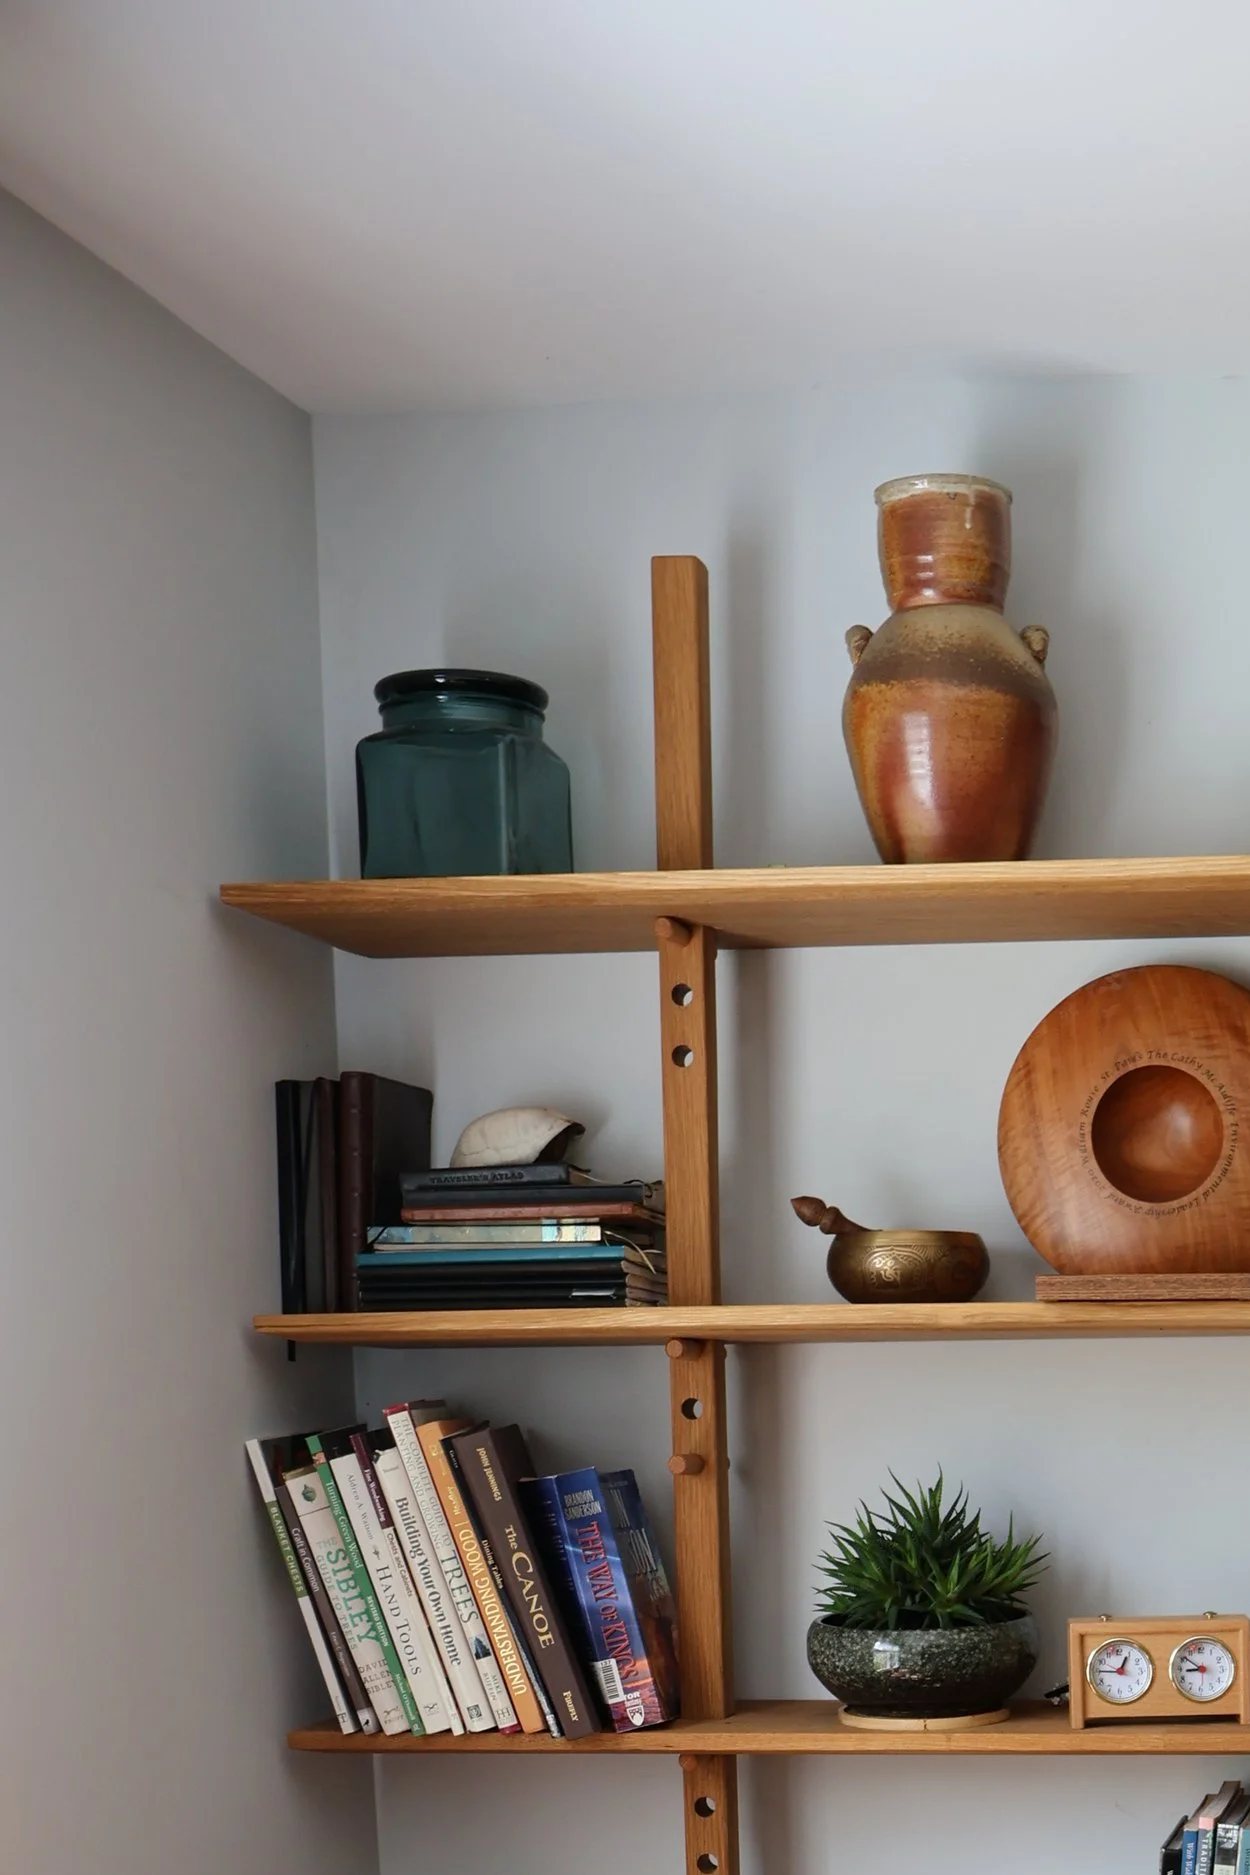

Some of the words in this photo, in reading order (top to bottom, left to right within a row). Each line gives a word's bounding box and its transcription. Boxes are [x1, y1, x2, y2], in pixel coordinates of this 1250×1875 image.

[491, 1171, 525, 1181] ATLAS
[391, 1420, 417, 1474] PLANTING
[410, 1475, 425, 1498] AND
[420, 1500, 445, 1550] GROWING
[476, 1447, 491, 1469] JOHN
[484, 1466, 502, 1502] JENNINGS
[563, 1489, 595, 1508] BRANDON
[563, 1500, 603, 1522] SANDERSON
[270, 1507, 290, 1552] BLANKET
[286, 1554, 304, 1592] CHESTS
[291, 1527, 304, 1547] Craft
[302, 1556, 320, 1593] Common
[459, 1529, 485, 1577] WOOD
[505, 1524, 518, 1550] The
[575, 1520, 605, 1564] THE
[326, 1548, 380, 1643] SIBLEY
[395, 1497, 425, 1559] Building
[417, 1558, 437, 1590] Your
[427, 1590, 448, 1622] Own
[439, 1623, 462, 1666] Home
[440, 1549, 480, 1625] TREES
[511, 1551, 556, 1649] CANOE
[586, 1568, 619, 1603] WAY
[376, 1565, 401, 1619] HAND
[396, 1617, 422, 1676] TOOLS
[475, 1577, 528, 1697] UNDERSTANDING
[600, 1604, 618, 1624] OF
[603, 1621, 640, 1681] KINGS
